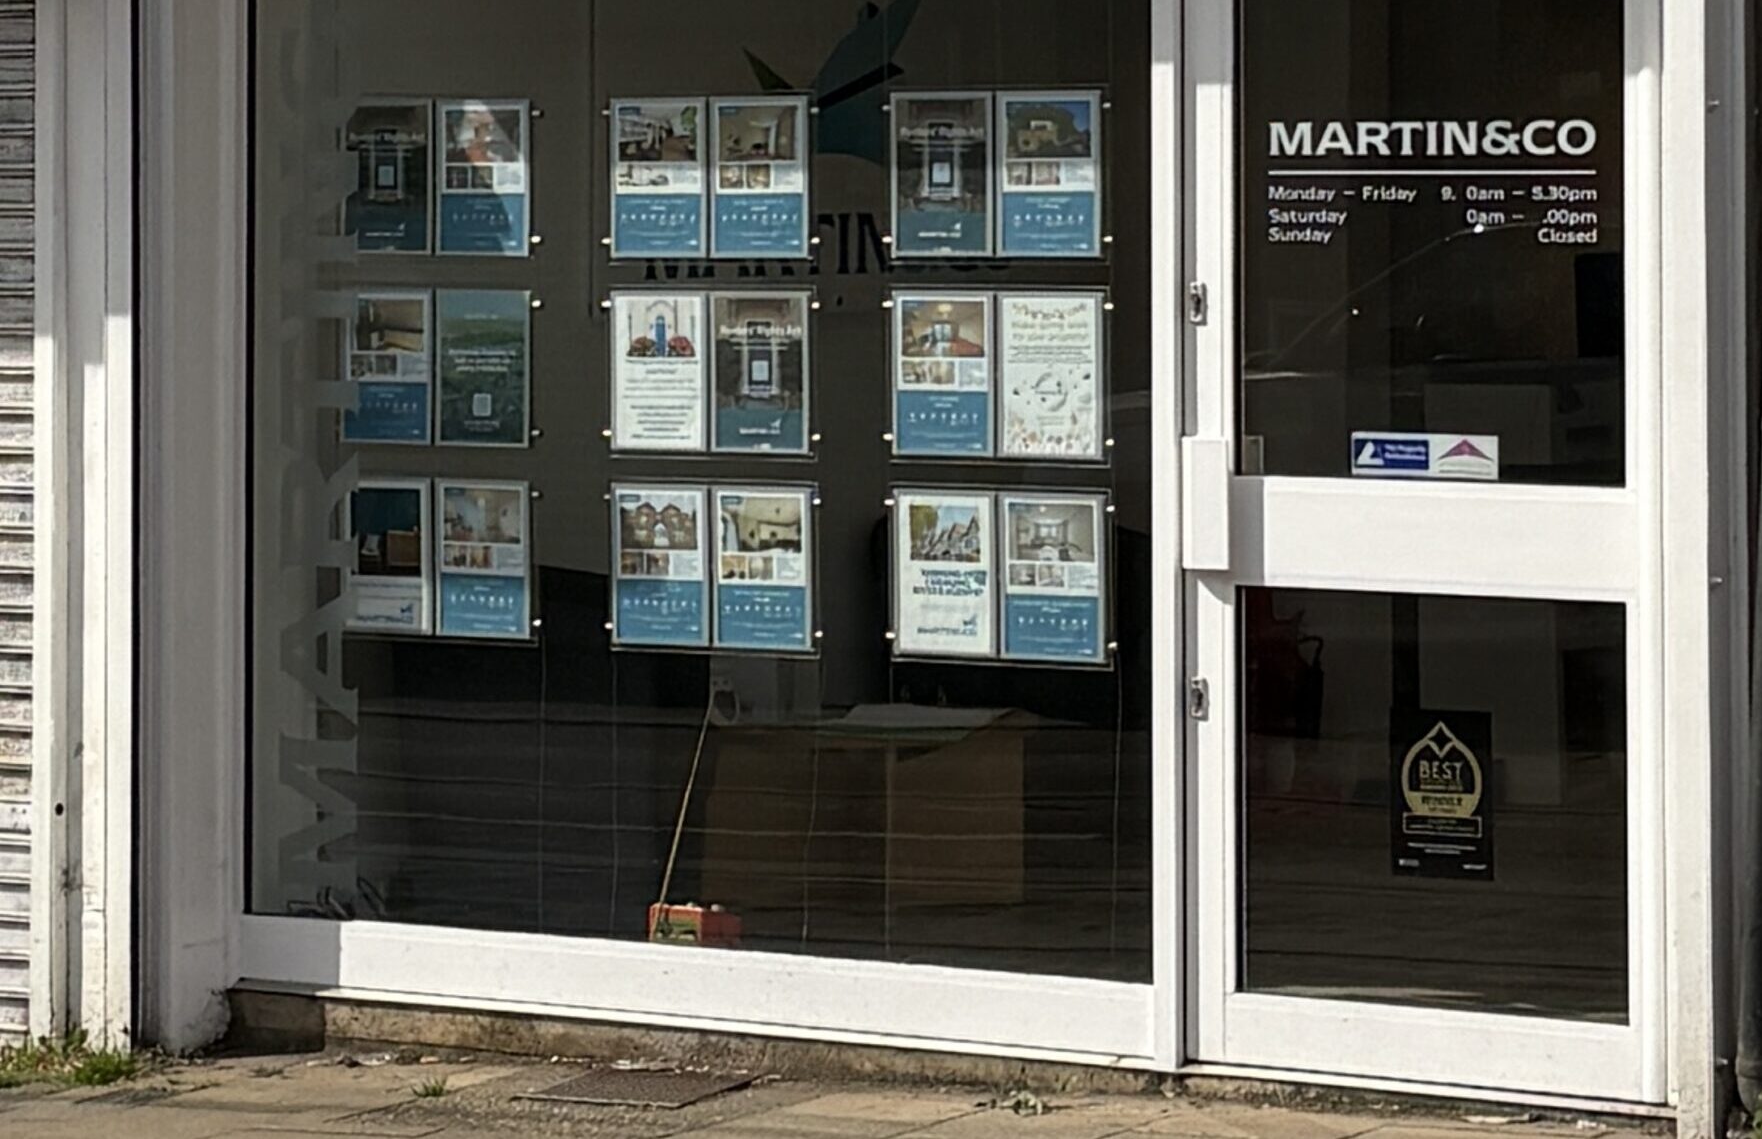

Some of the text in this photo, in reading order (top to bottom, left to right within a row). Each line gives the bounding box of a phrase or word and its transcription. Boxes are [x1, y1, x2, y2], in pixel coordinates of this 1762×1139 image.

[1268, 119, 1597, 157] MARTIN&CO
[1268, 185, 1336, 202] Monday
[1362, 185, 1417, 203] Friday
[1268, 208, 1347, 227] Saturday
[1268, 226, 1597, 244] Sunday Closed
[1419, 760, 1463, 783] BEST
